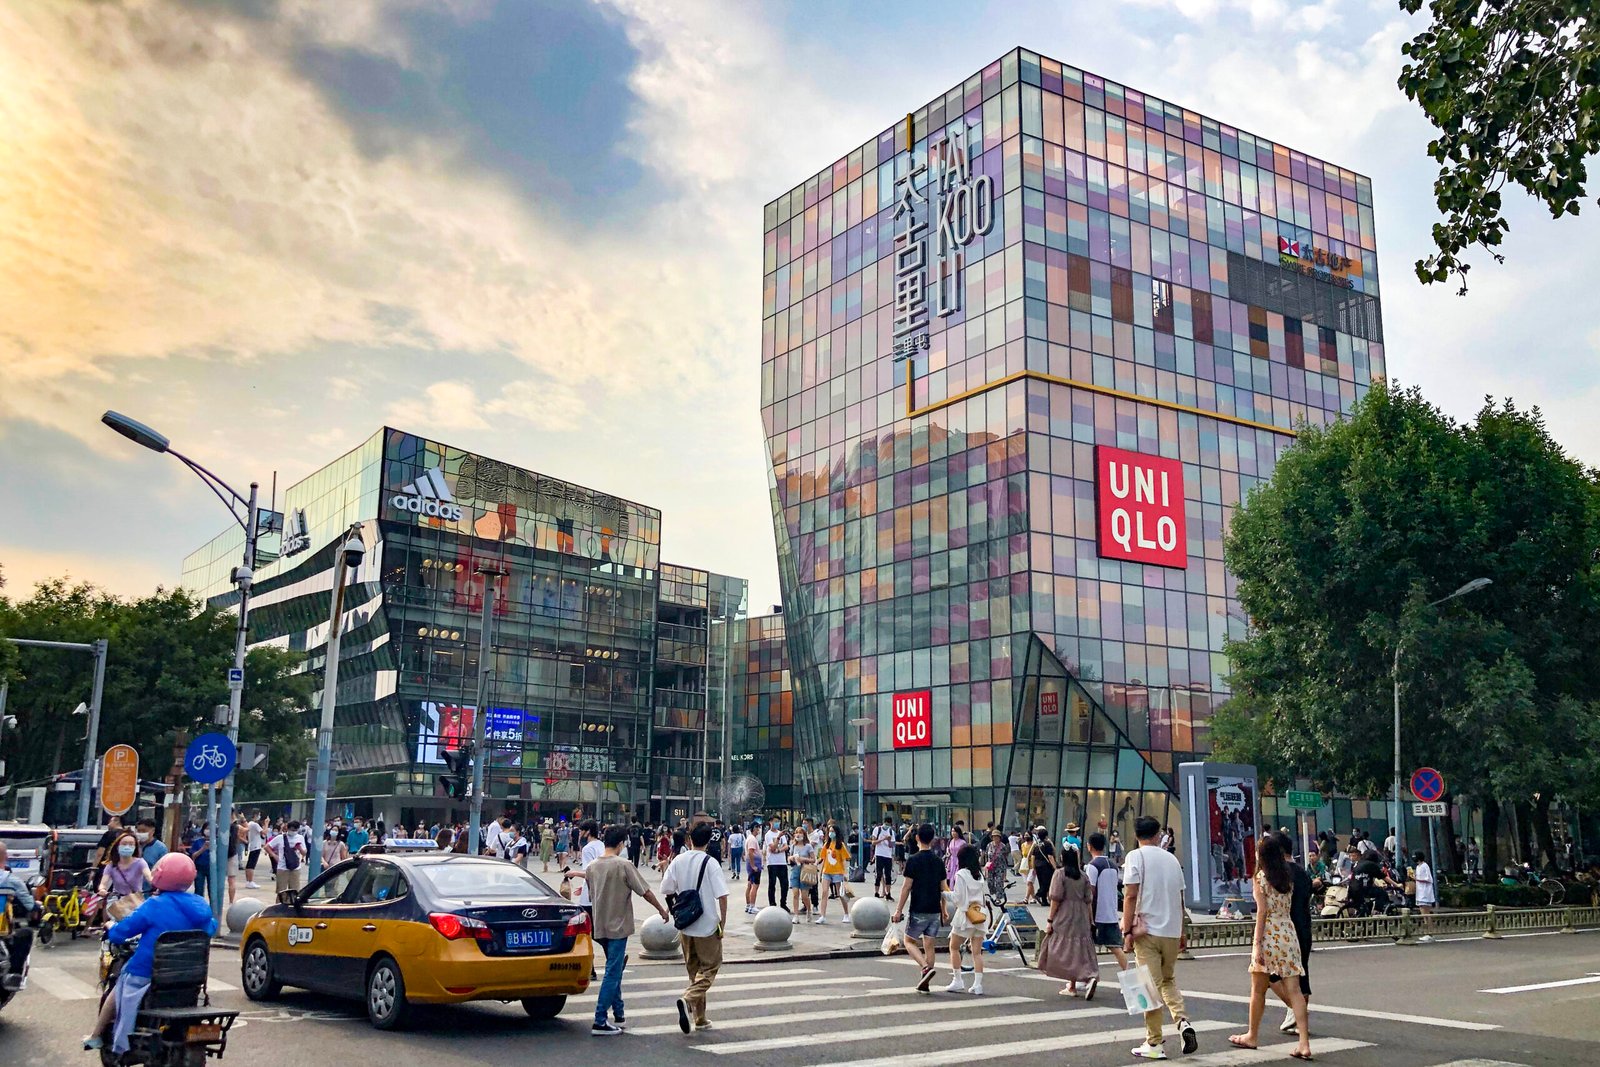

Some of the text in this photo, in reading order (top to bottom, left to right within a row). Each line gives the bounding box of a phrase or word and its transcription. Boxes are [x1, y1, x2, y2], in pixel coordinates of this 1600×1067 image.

[931, 123, 970, 195] TAI
[937, 174, 993, 256] KOO
[893, 157, 928, 337] 太古里
[936, 253, 962, 318] LI
[892, 332, 929, 362] 三里屯
[1109, 461, 1169, 507] UNI
[389, 495, 463, 521] adidas
[1111, 508, 1177, 552] QLO
[896, 697, 923, 718] UNI
[1042, 694, 1056, 704] UNI
[1042, 704, 1057, 714] QLO
[896, 720, 926, 744] QLO
[711, 832, 721, 842] 29
